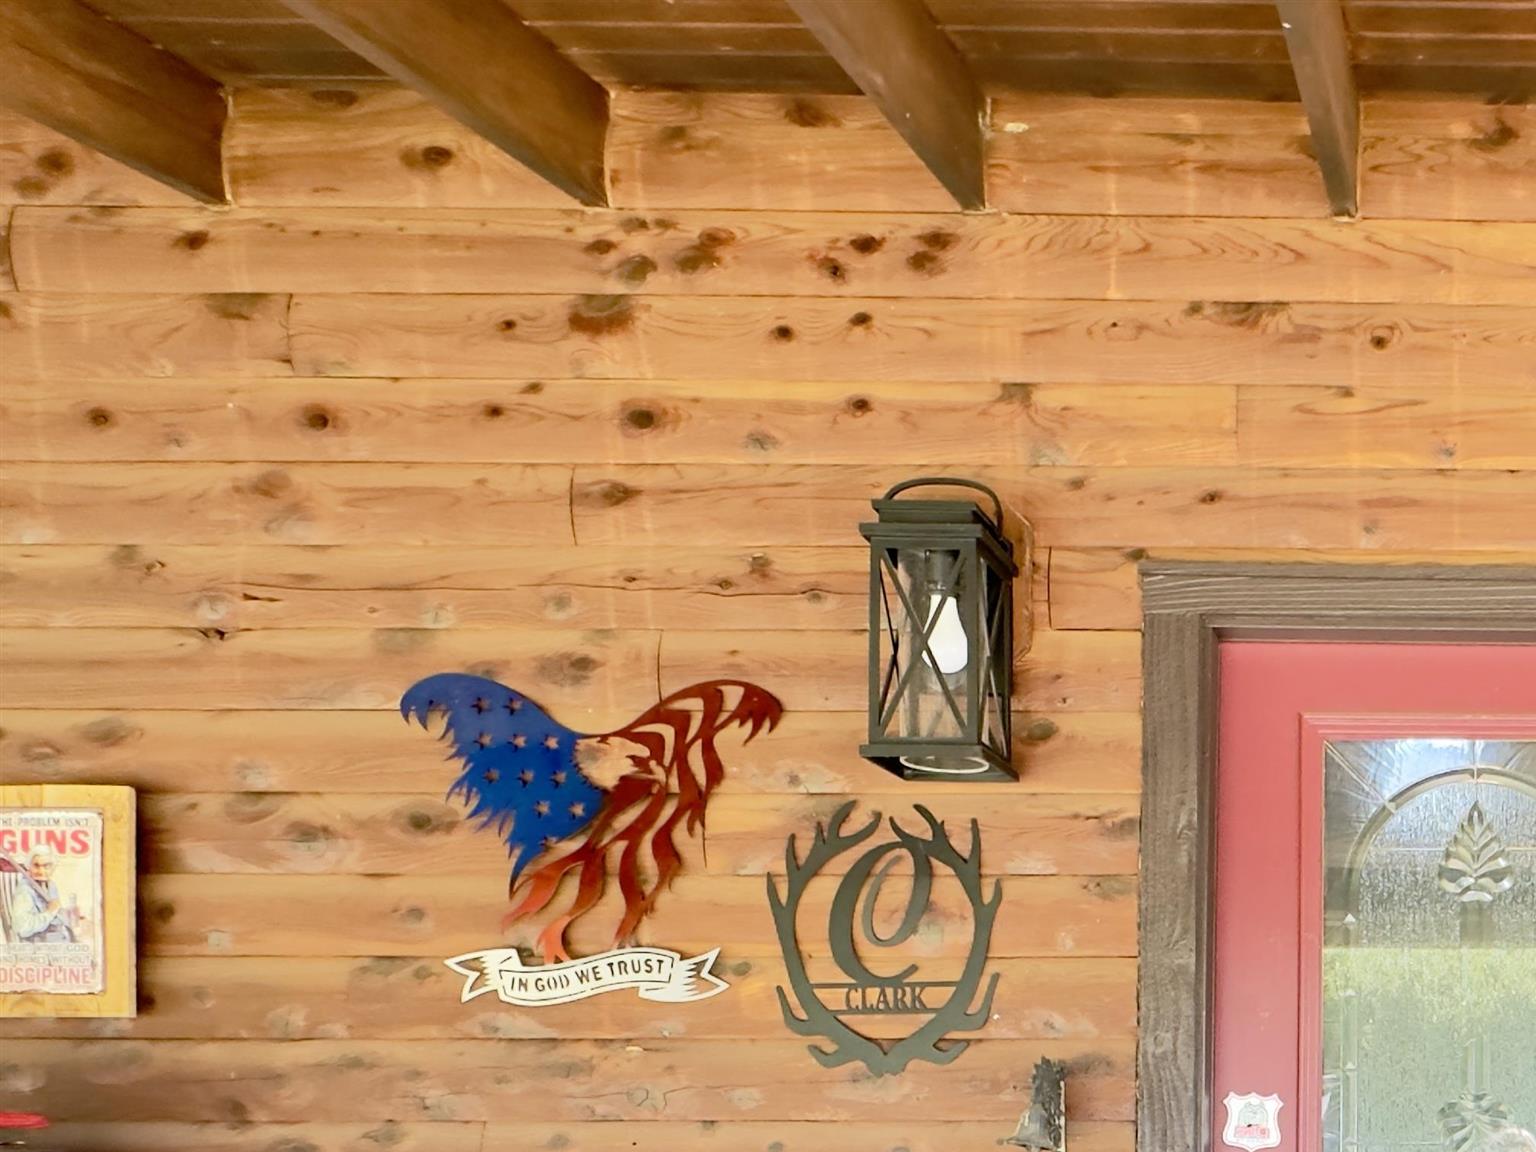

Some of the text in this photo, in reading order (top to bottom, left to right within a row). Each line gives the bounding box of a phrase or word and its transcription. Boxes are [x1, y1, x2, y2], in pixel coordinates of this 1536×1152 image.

[18, 817, 60, 826] PROBLEM
[0, 829, 90, 854] GUNS
[0, 967, 90, 984] DISCIPLINE
[510, 958, 665, 992] IN GOD WE TRUST
[845, 988, 928, 1010] CLARK
